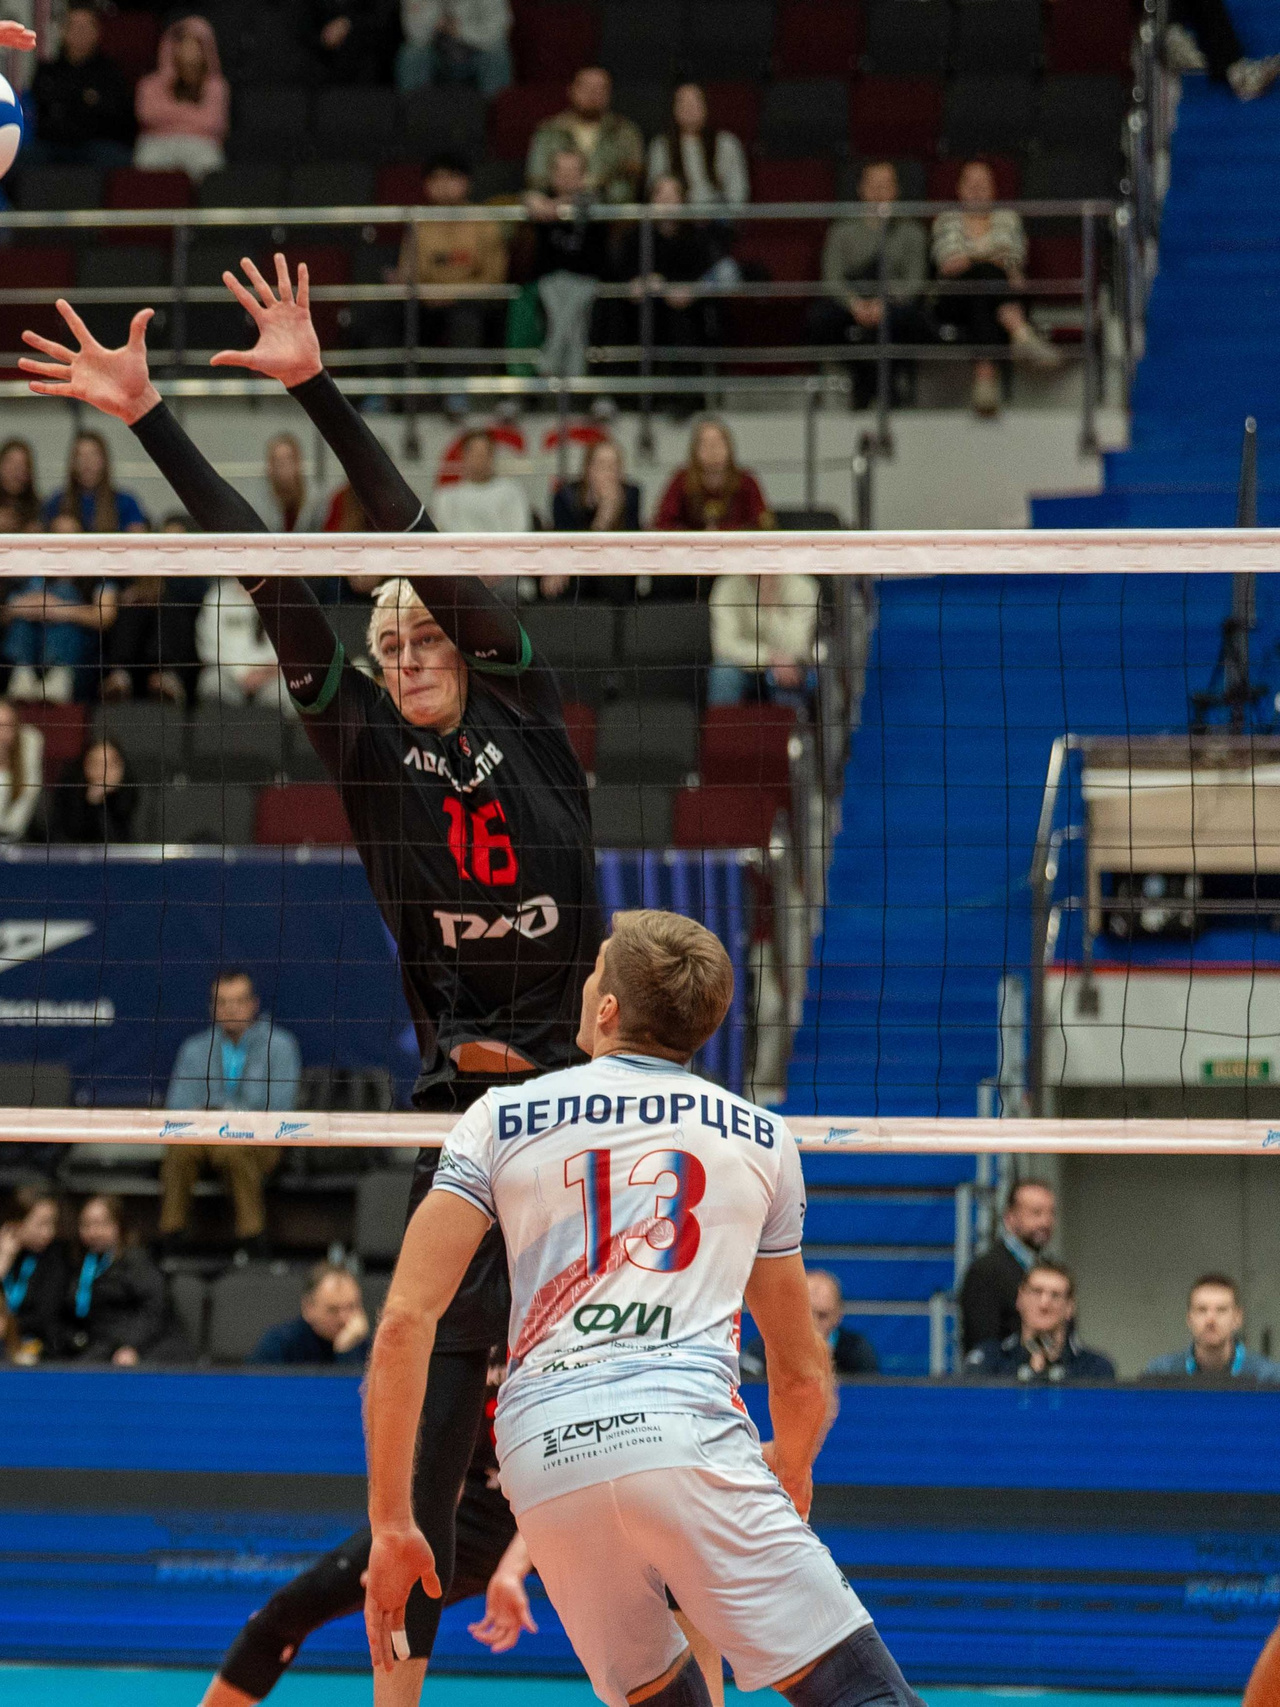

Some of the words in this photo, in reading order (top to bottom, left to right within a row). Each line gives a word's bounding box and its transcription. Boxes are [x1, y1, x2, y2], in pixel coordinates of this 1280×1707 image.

[404, 741, 505, 793] ЛОКТИВ
[442, 796, 519, 886] 16
[433, 894, 560, 949] РЖД
[498, 1093, 775, 1150] БЕЛОГОРЦЕВ
[564, 1149, 707, 1279] 13
[543, 1458, 562, 1471] LIVE
[565, 1450, 598, 1463] BETTER
[604, 1442, 623, 1454] LIVE
[626, 1436, 663, 1447] LONGER
[605, 1425, 662, 1441] INTERNATIONAL
